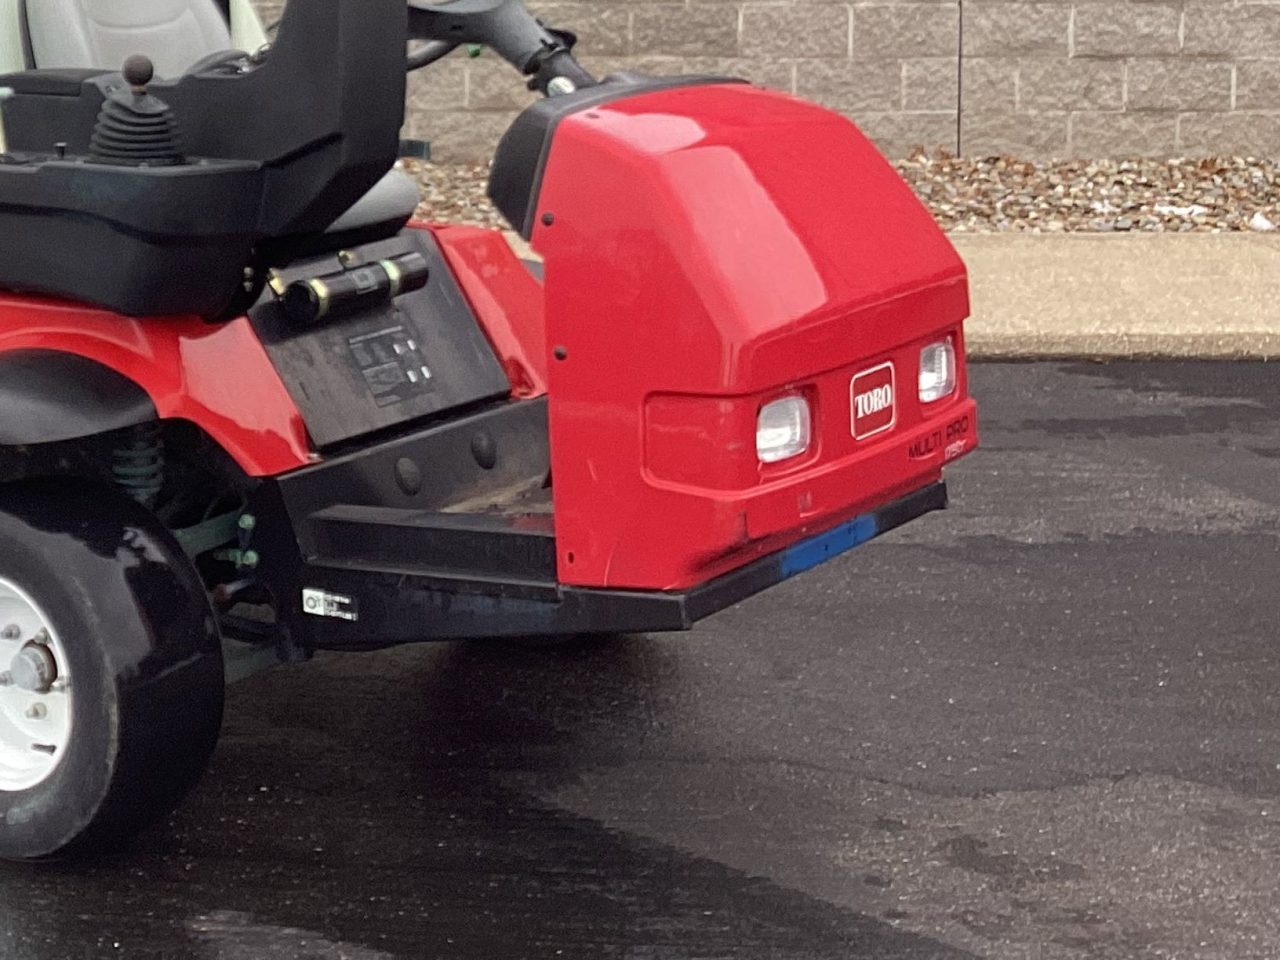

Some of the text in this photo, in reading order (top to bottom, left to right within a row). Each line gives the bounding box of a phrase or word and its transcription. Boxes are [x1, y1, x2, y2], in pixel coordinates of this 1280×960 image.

[854, 384, 892, 419] TORO
[909, 430, 941, 458] MULTI
[947, 416, 968, 441] PRO
